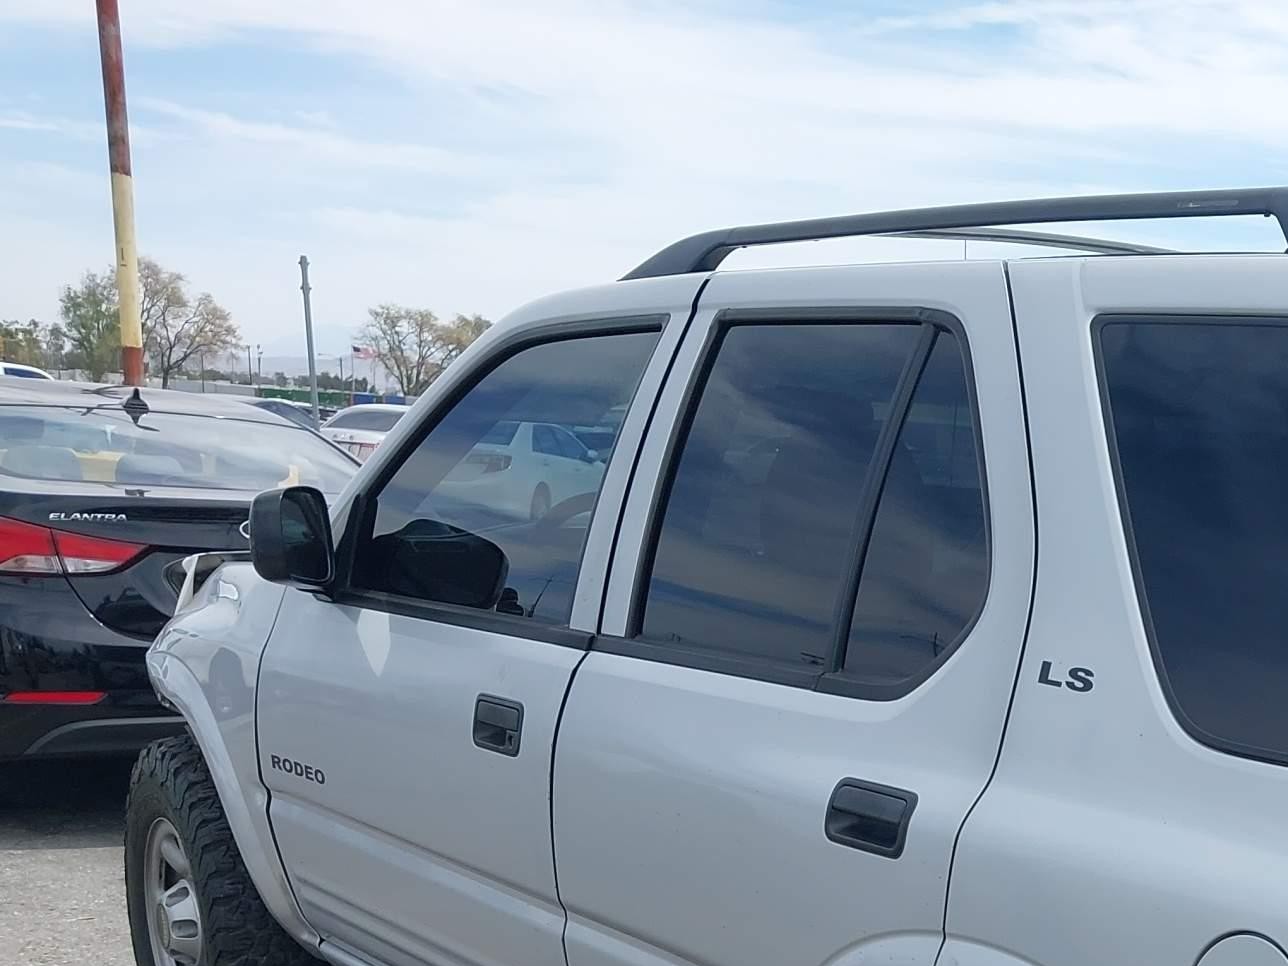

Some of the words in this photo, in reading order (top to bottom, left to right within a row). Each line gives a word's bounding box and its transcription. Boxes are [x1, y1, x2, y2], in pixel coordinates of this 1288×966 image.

[48, 512, 128, 522] ELANTRA
[1037, 660, 1095, 693] LS
[271, 754, 326, 785] RODEO
